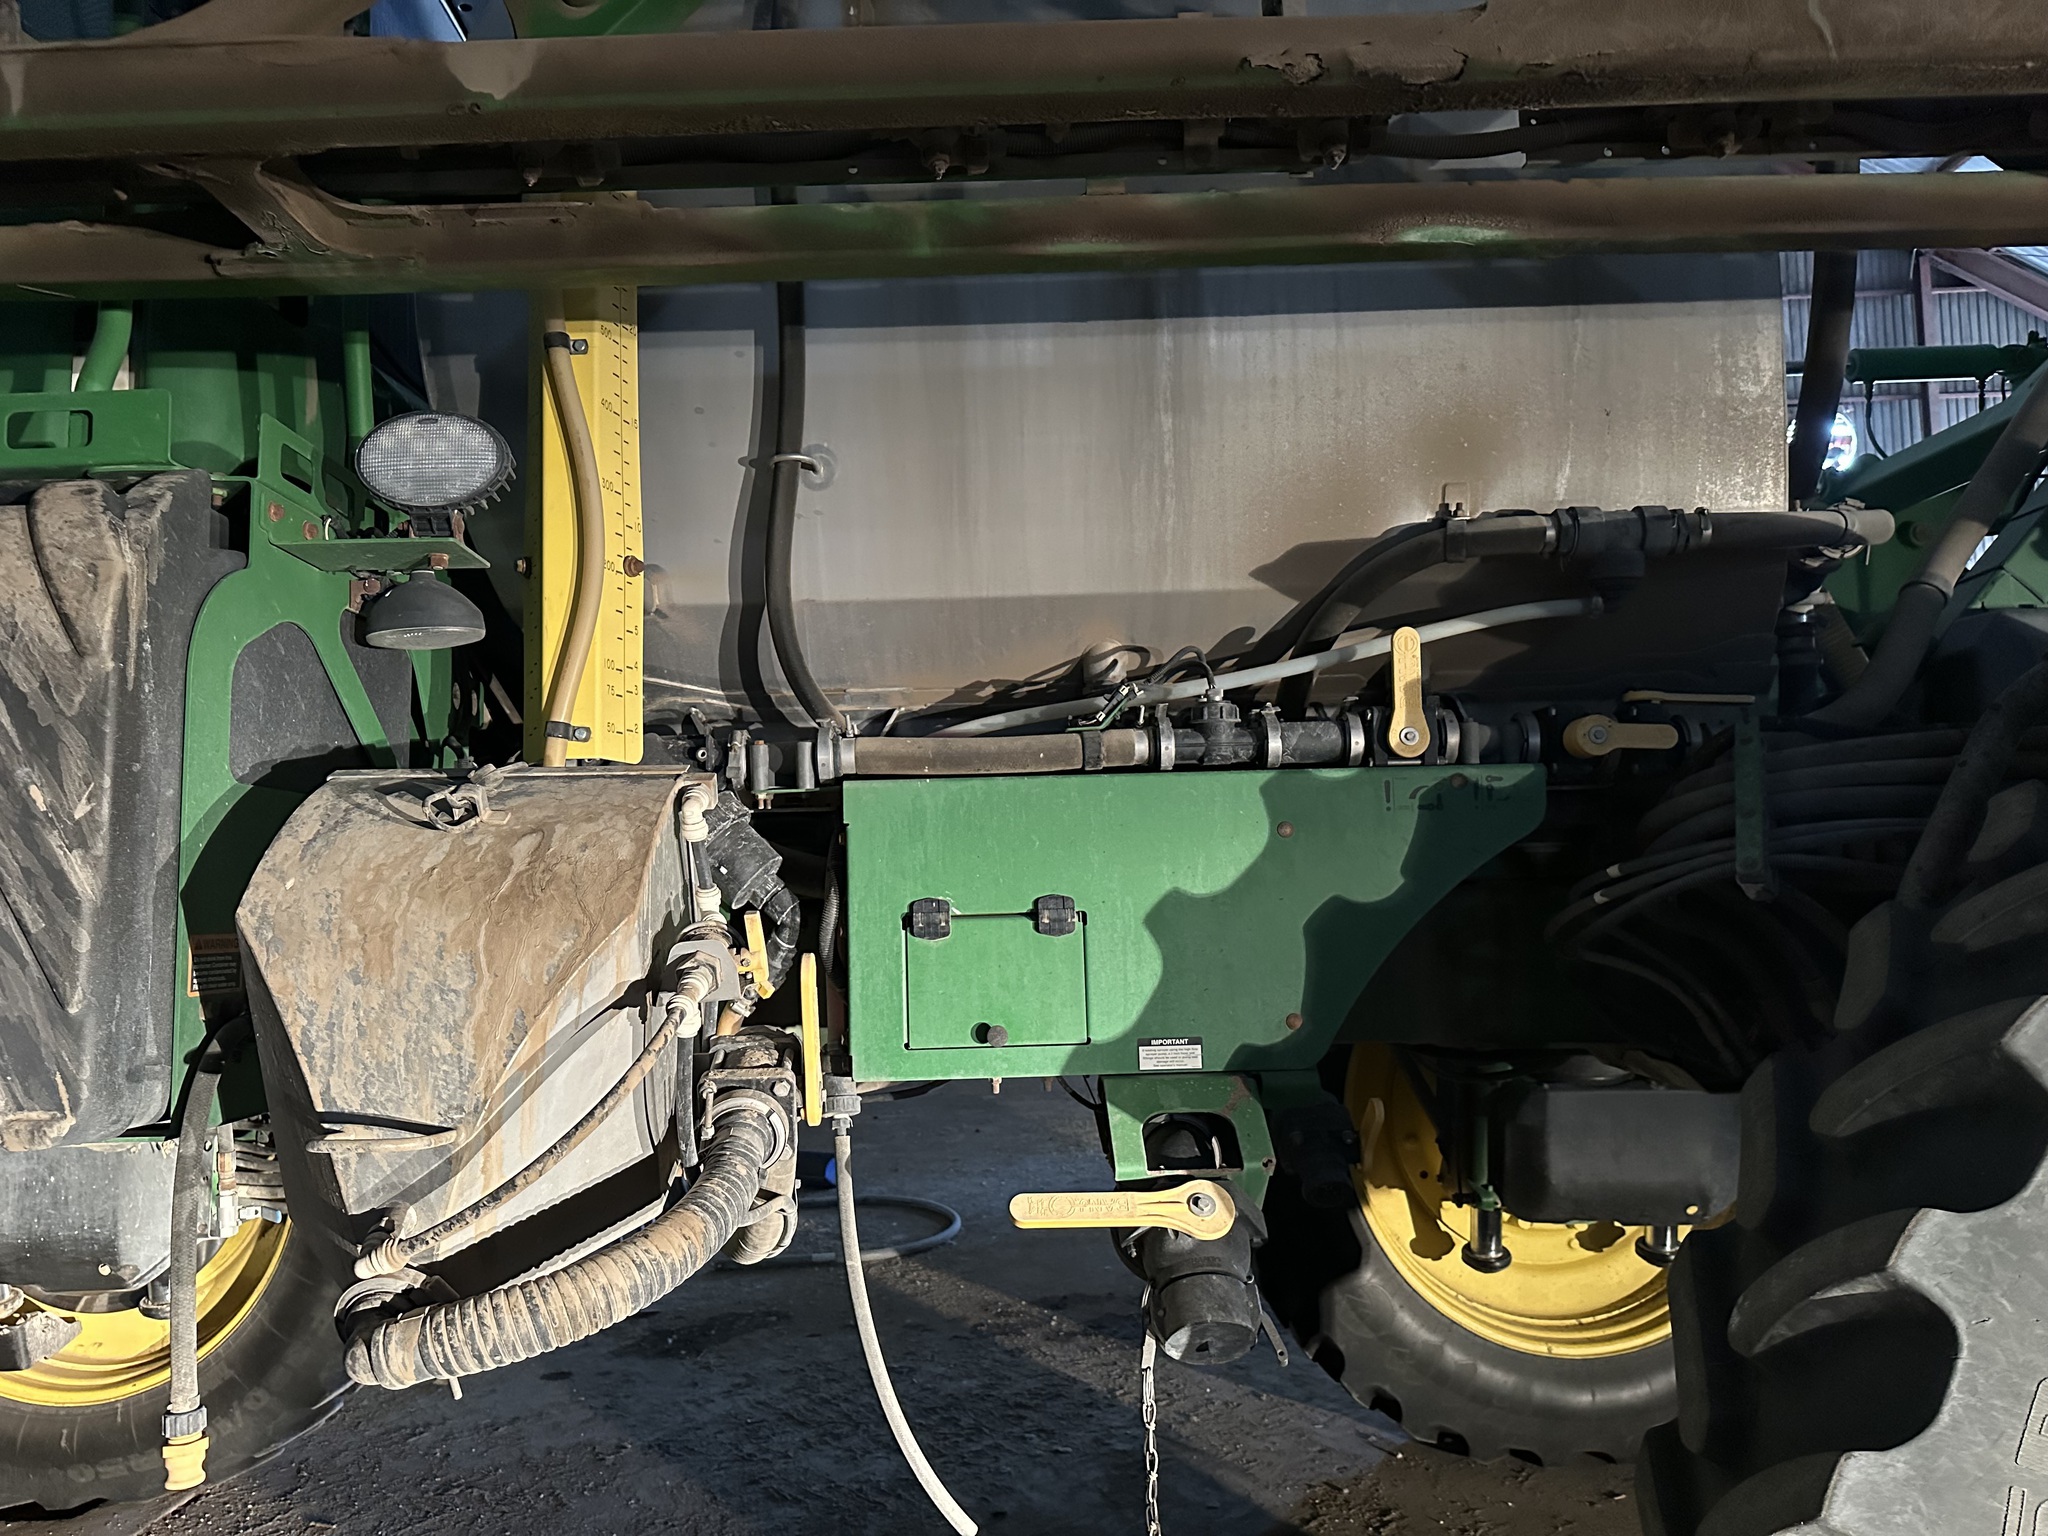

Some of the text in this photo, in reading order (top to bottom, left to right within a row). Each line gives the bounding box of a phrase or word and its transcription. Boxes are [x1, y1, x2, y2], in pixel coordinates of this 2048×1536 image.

[600, 324, 613, 341] 500
[600, 397, 613, 412] 400
[601, 477, 614, 492] 300
[603, 658, 615, 671] 100
[606, 684, 615, 696] 75
[606, 722, 616, 734] 50
[202, 938, 239, 950] WARNING
